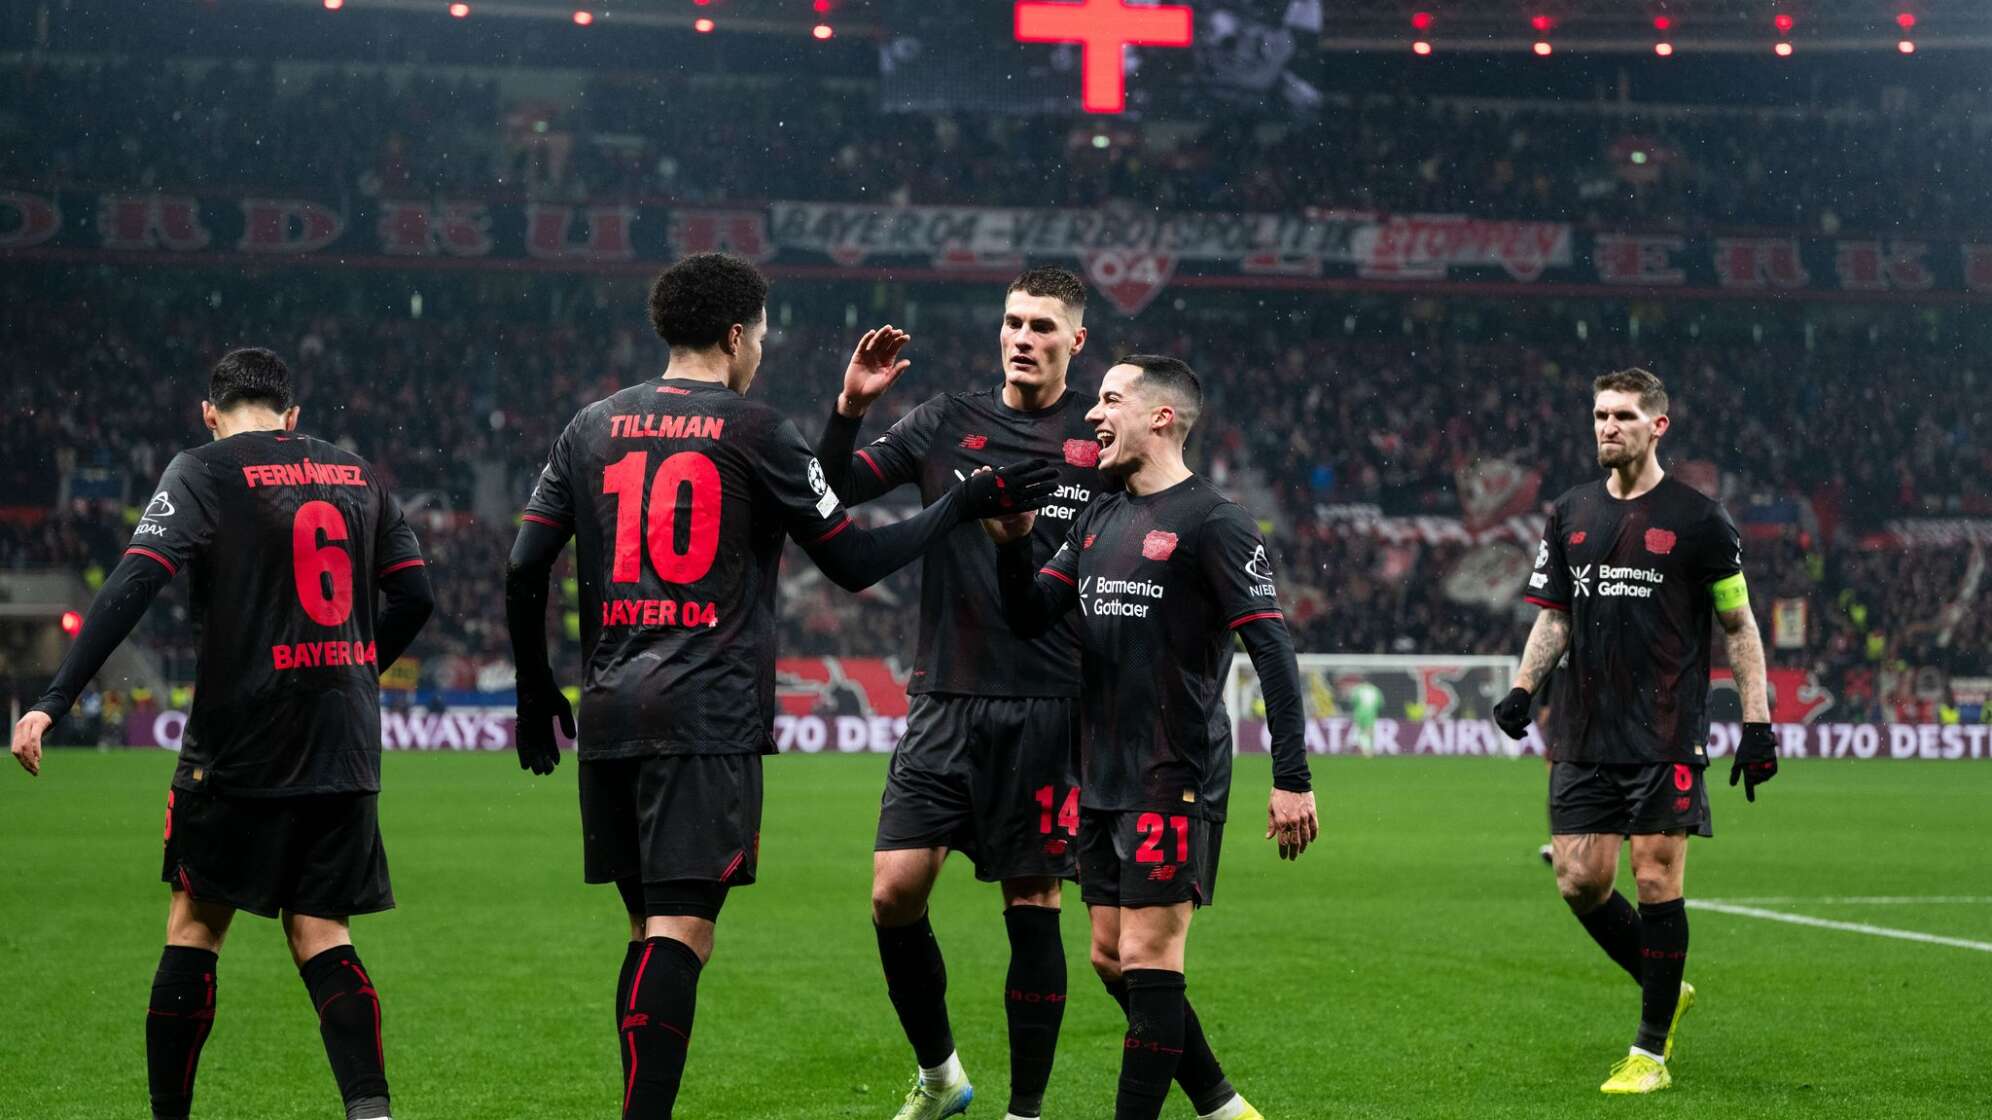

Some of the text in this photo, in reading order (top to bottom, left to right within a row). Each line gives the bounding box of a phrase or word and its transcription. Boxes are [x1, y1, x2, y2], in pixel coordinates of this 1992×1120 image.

[610, 414, 725, 441] TILLMAN
[242, 457, 368, 488] FERNÁNDEZ
[1053, 483, 1090, 502] enia
[133, 522, 168, 537] EDAX
[602, 451, 722, 585] 10
[292, 500, 354, 628] 6
[1599, 564, 1664, 583] Barmenia
[1096, 576, 1164, 599] Barmenia
[1249, 584, 1277, 598] NIED
[1598, 581, 1653, 599] Gothaer
[682, 601, 718, 627] 04
[1093, 598, 1149, 618] Gothaer
[271, 641, 352, 671] BAYER
[774, 715, 828, 752] 70
[1816, 722, 1880, 759] 170
[1889, 723, 1992, 760] DEST
[1034, 785, 1081, 836] 14
[1135, 811, 1190, 863] 21
